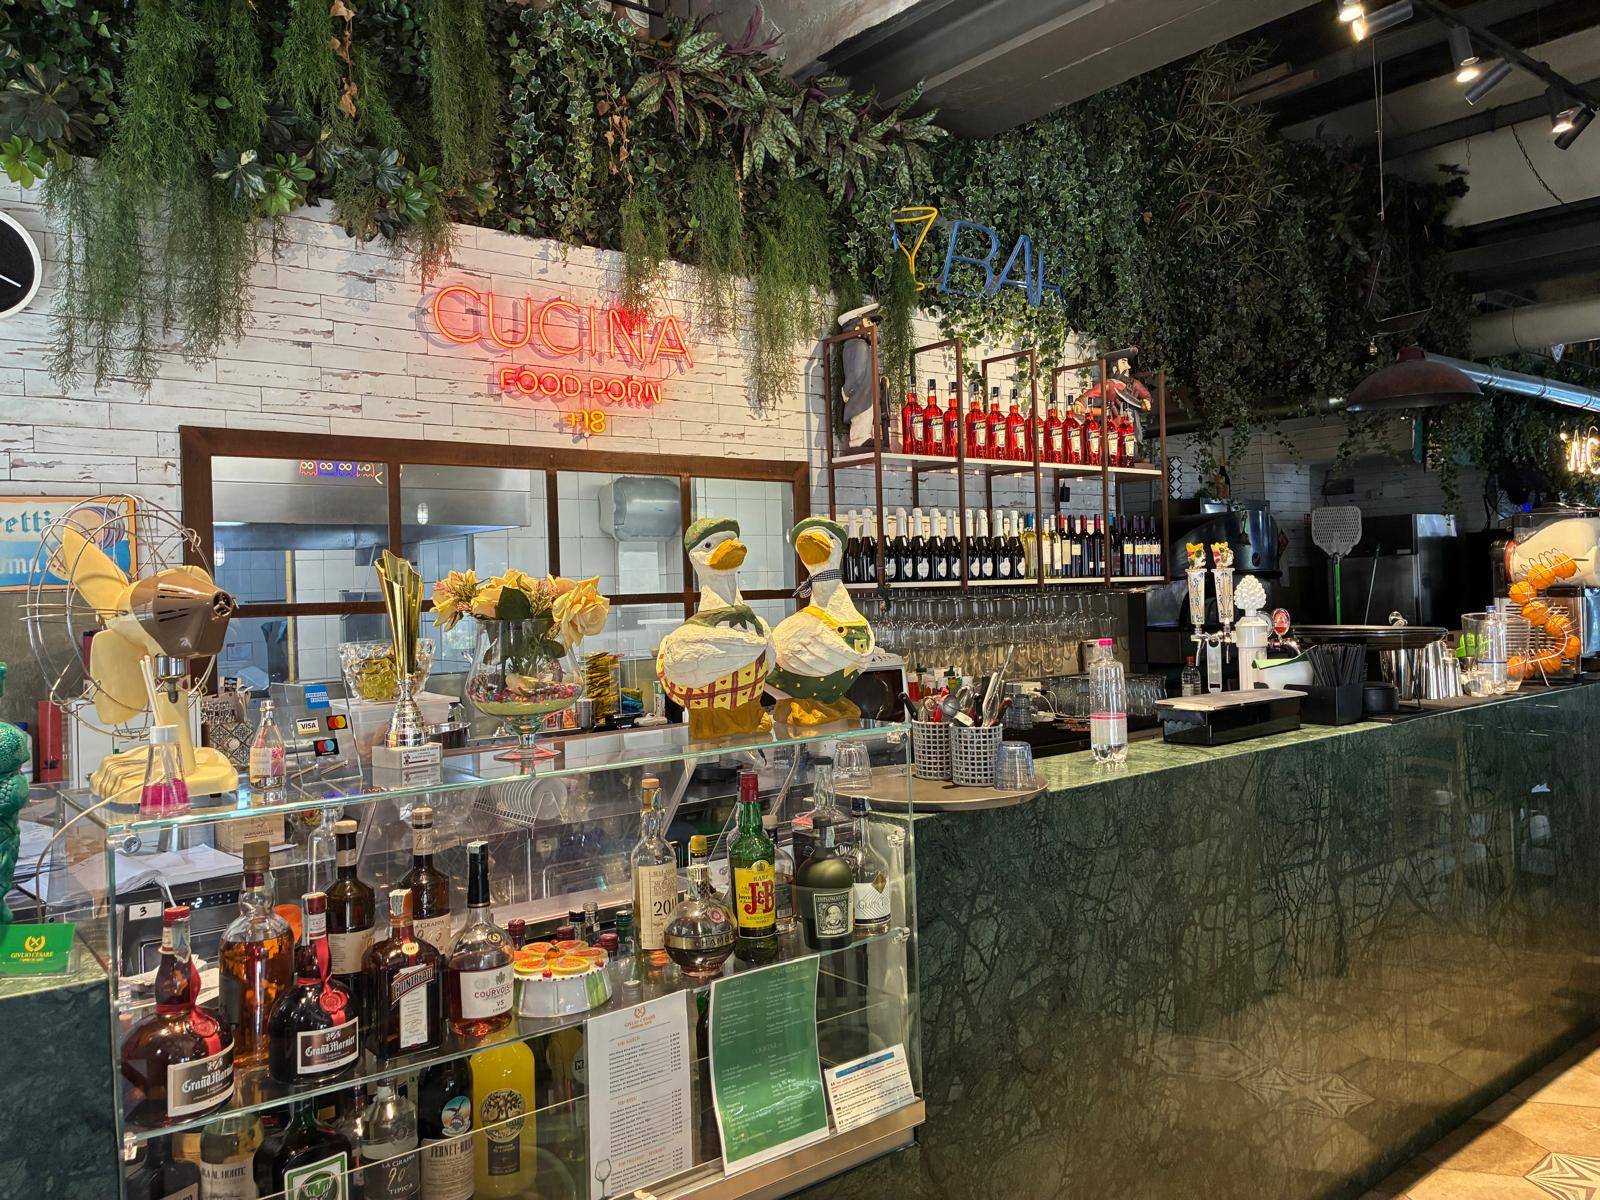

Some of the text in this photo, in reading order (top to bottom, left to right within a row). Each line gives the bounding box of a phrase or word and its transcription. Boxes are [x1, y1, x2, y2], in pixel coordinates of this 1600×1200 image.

[433, 285, 694, 368] CUCINA
[499, 368, 662, 403] FOOD PORN
[564, 408, 606, 433] +18
[0, 509, 51, 533] etti
[744, 879, 776, 915] J&B
[139, 906, 147, 916] 3
[392, 967, 433, 999] COINTREAU
[304, 1035, 355, 1058] Grand Marnier
[181, 1075, 211, 1093] Grand
[389, 1183, 413, 1195] TIPICA
